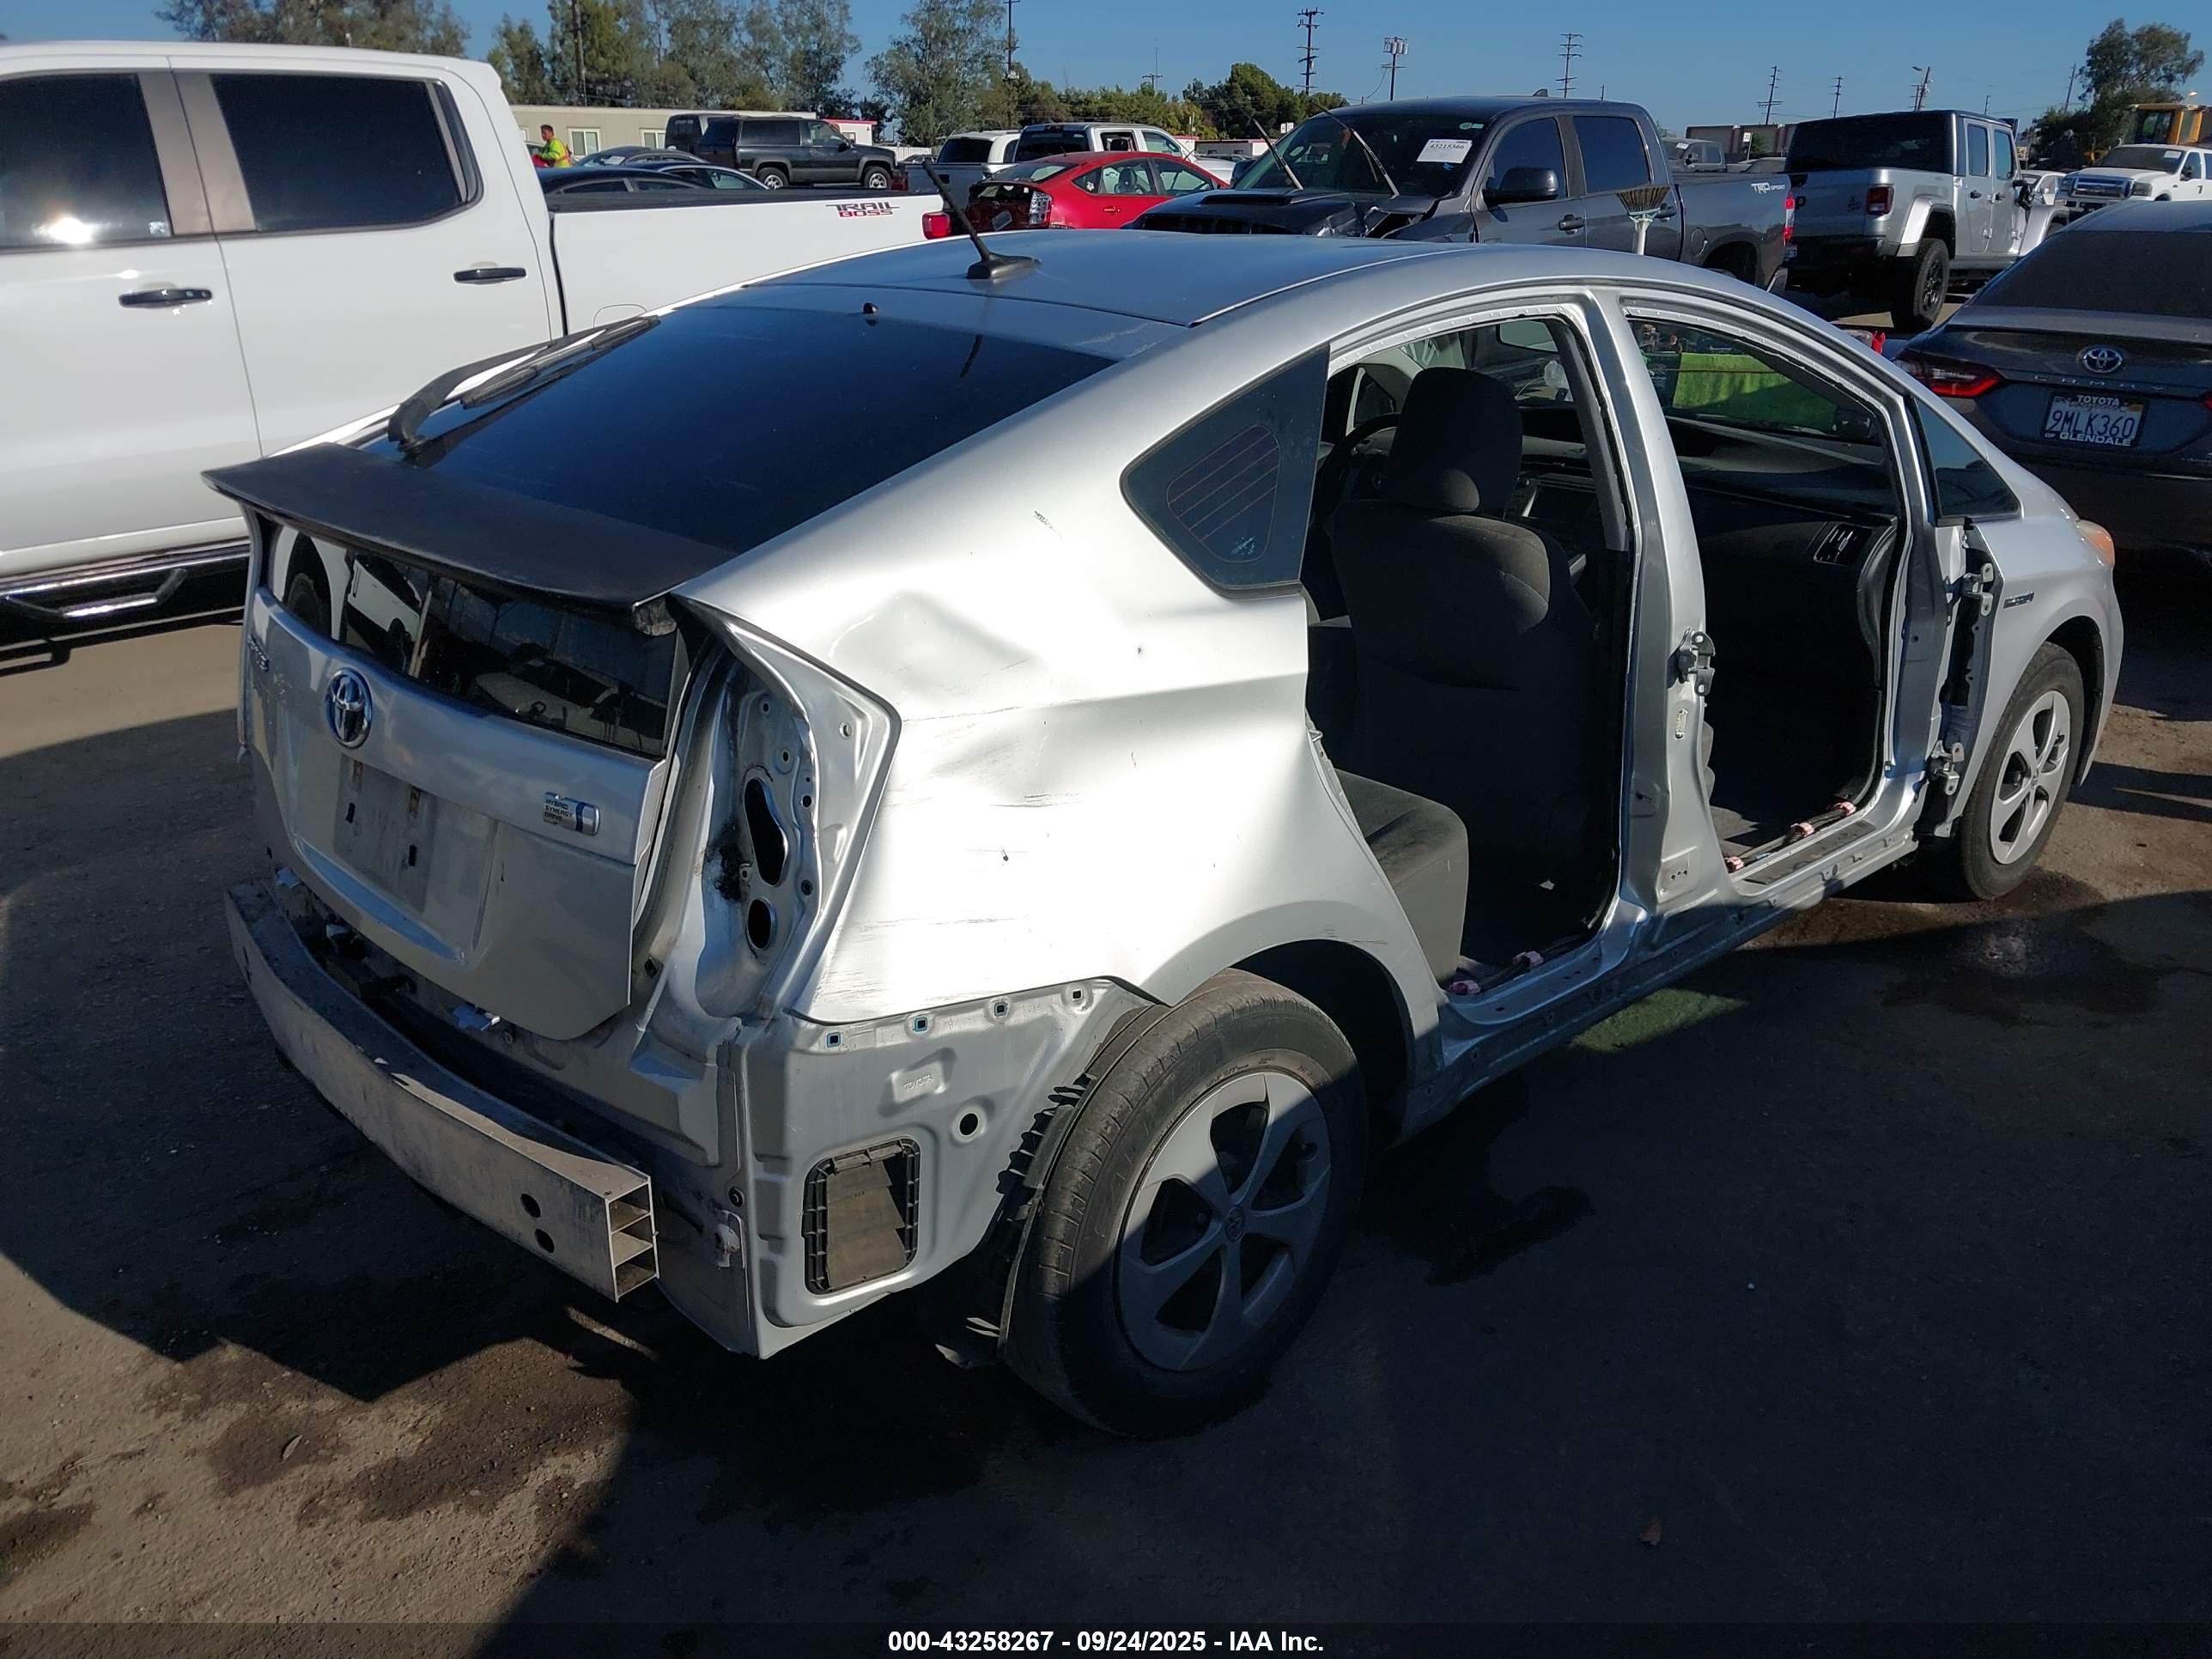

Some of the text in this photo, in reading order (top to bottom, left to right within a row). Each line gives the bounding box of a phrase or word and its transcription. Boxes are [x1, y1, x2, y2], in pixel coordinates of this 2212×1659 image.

[1751, 181, 1770, 194] TRD
[825, 201, 900, 212] TRAIL
[838, 209, 893, 218] BOSS
[2076, 394, 2120, 406] TOYOTA
[2048, 410, 2136, 438] 9MLK360
[2059, 431, 2131, 447] GLENDALE
[544, 805, 573, 817] SYNERGY
